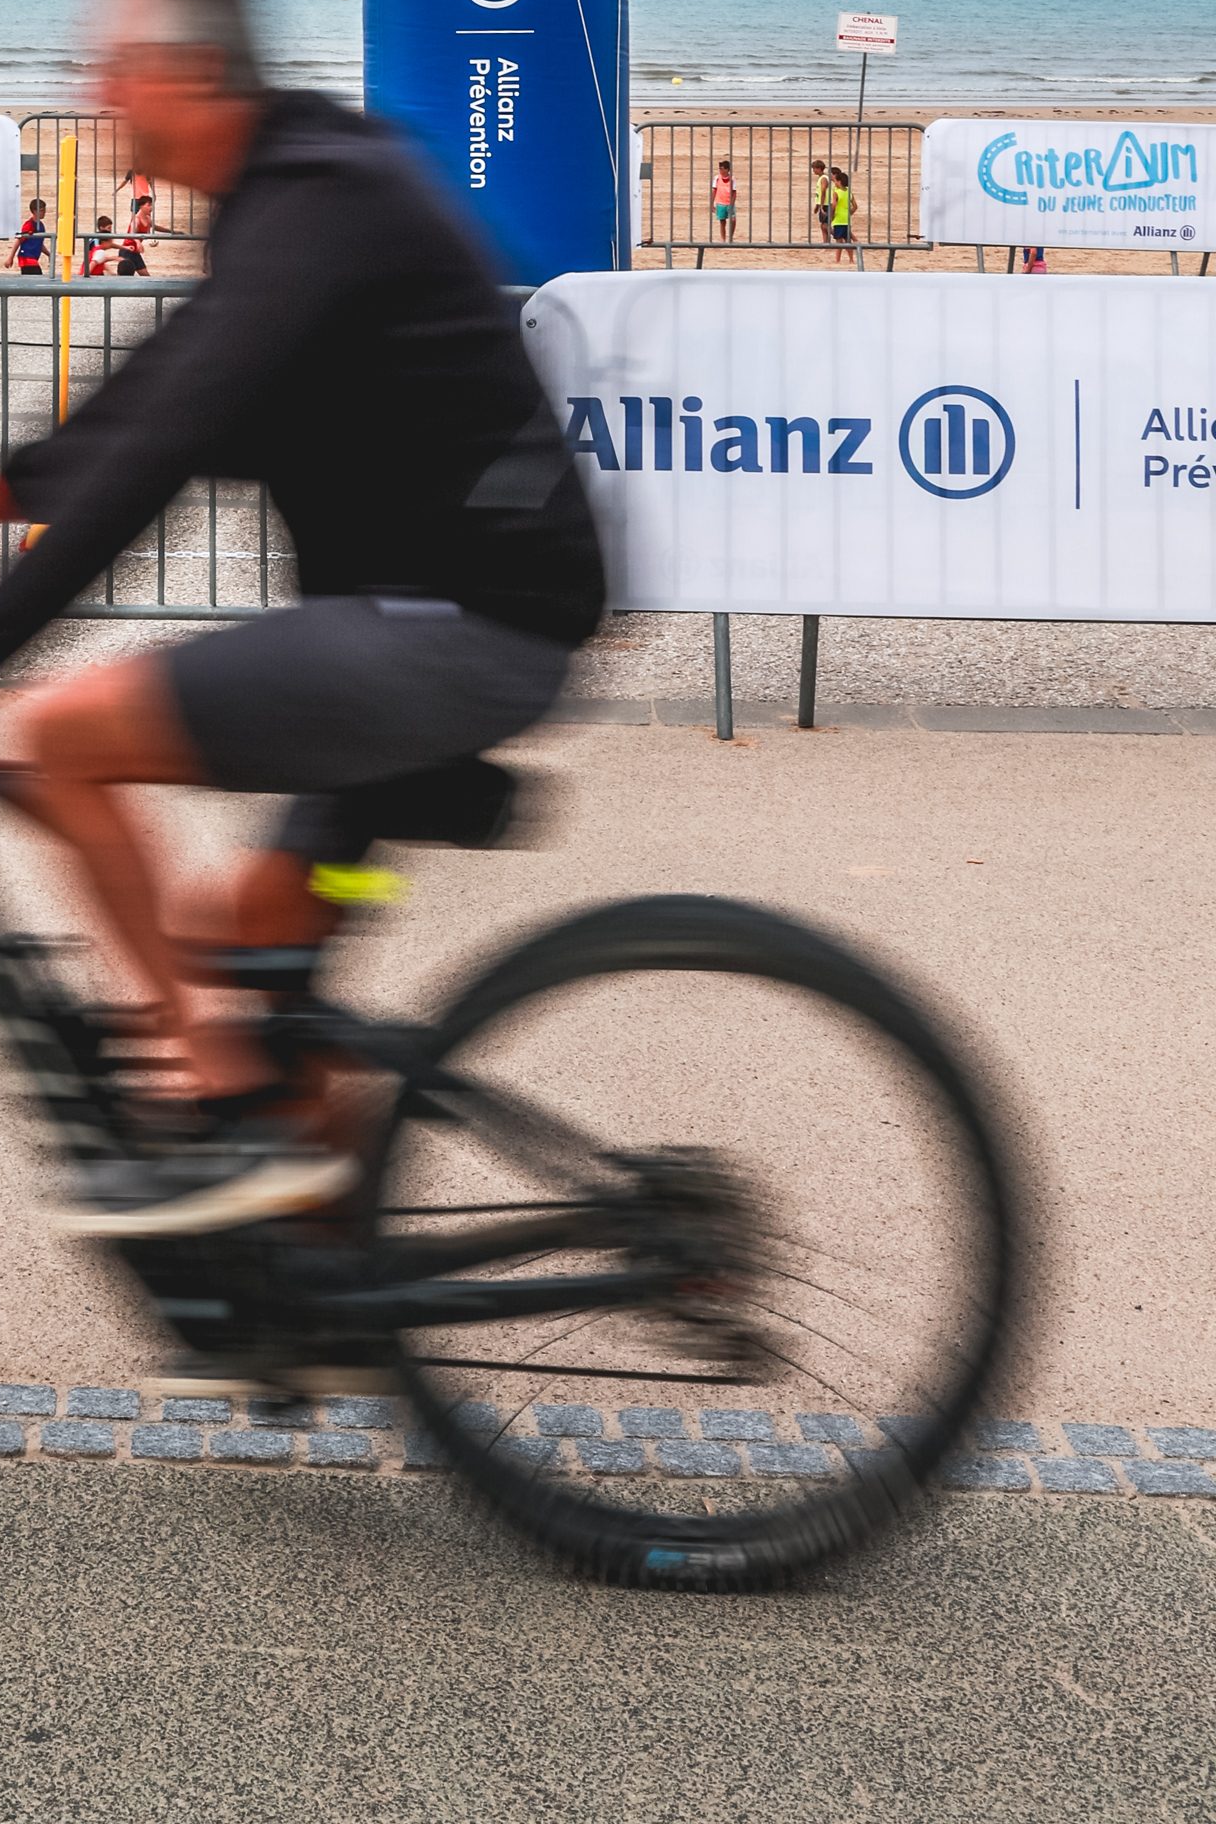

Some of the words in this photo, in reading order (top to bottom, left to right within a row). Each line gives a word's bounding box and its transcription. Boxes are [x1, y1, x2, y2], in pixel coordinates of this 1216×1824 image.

[852, 16, 883, 24] CHENAL
[497, 57, 520, 143] Allianz
[468, 57, 493, 189] Prévention
[1037, 196, 1057, 213] DU
[1062, 194, 1104, 213] JEUNE
[1109, 194, 1197, 213] CONDUCTEUR
[1133, 225, 1177, 238] Allianz
[564, 395, 873, 475] Allianz
[1141, 407, 1216, 441] Alli
